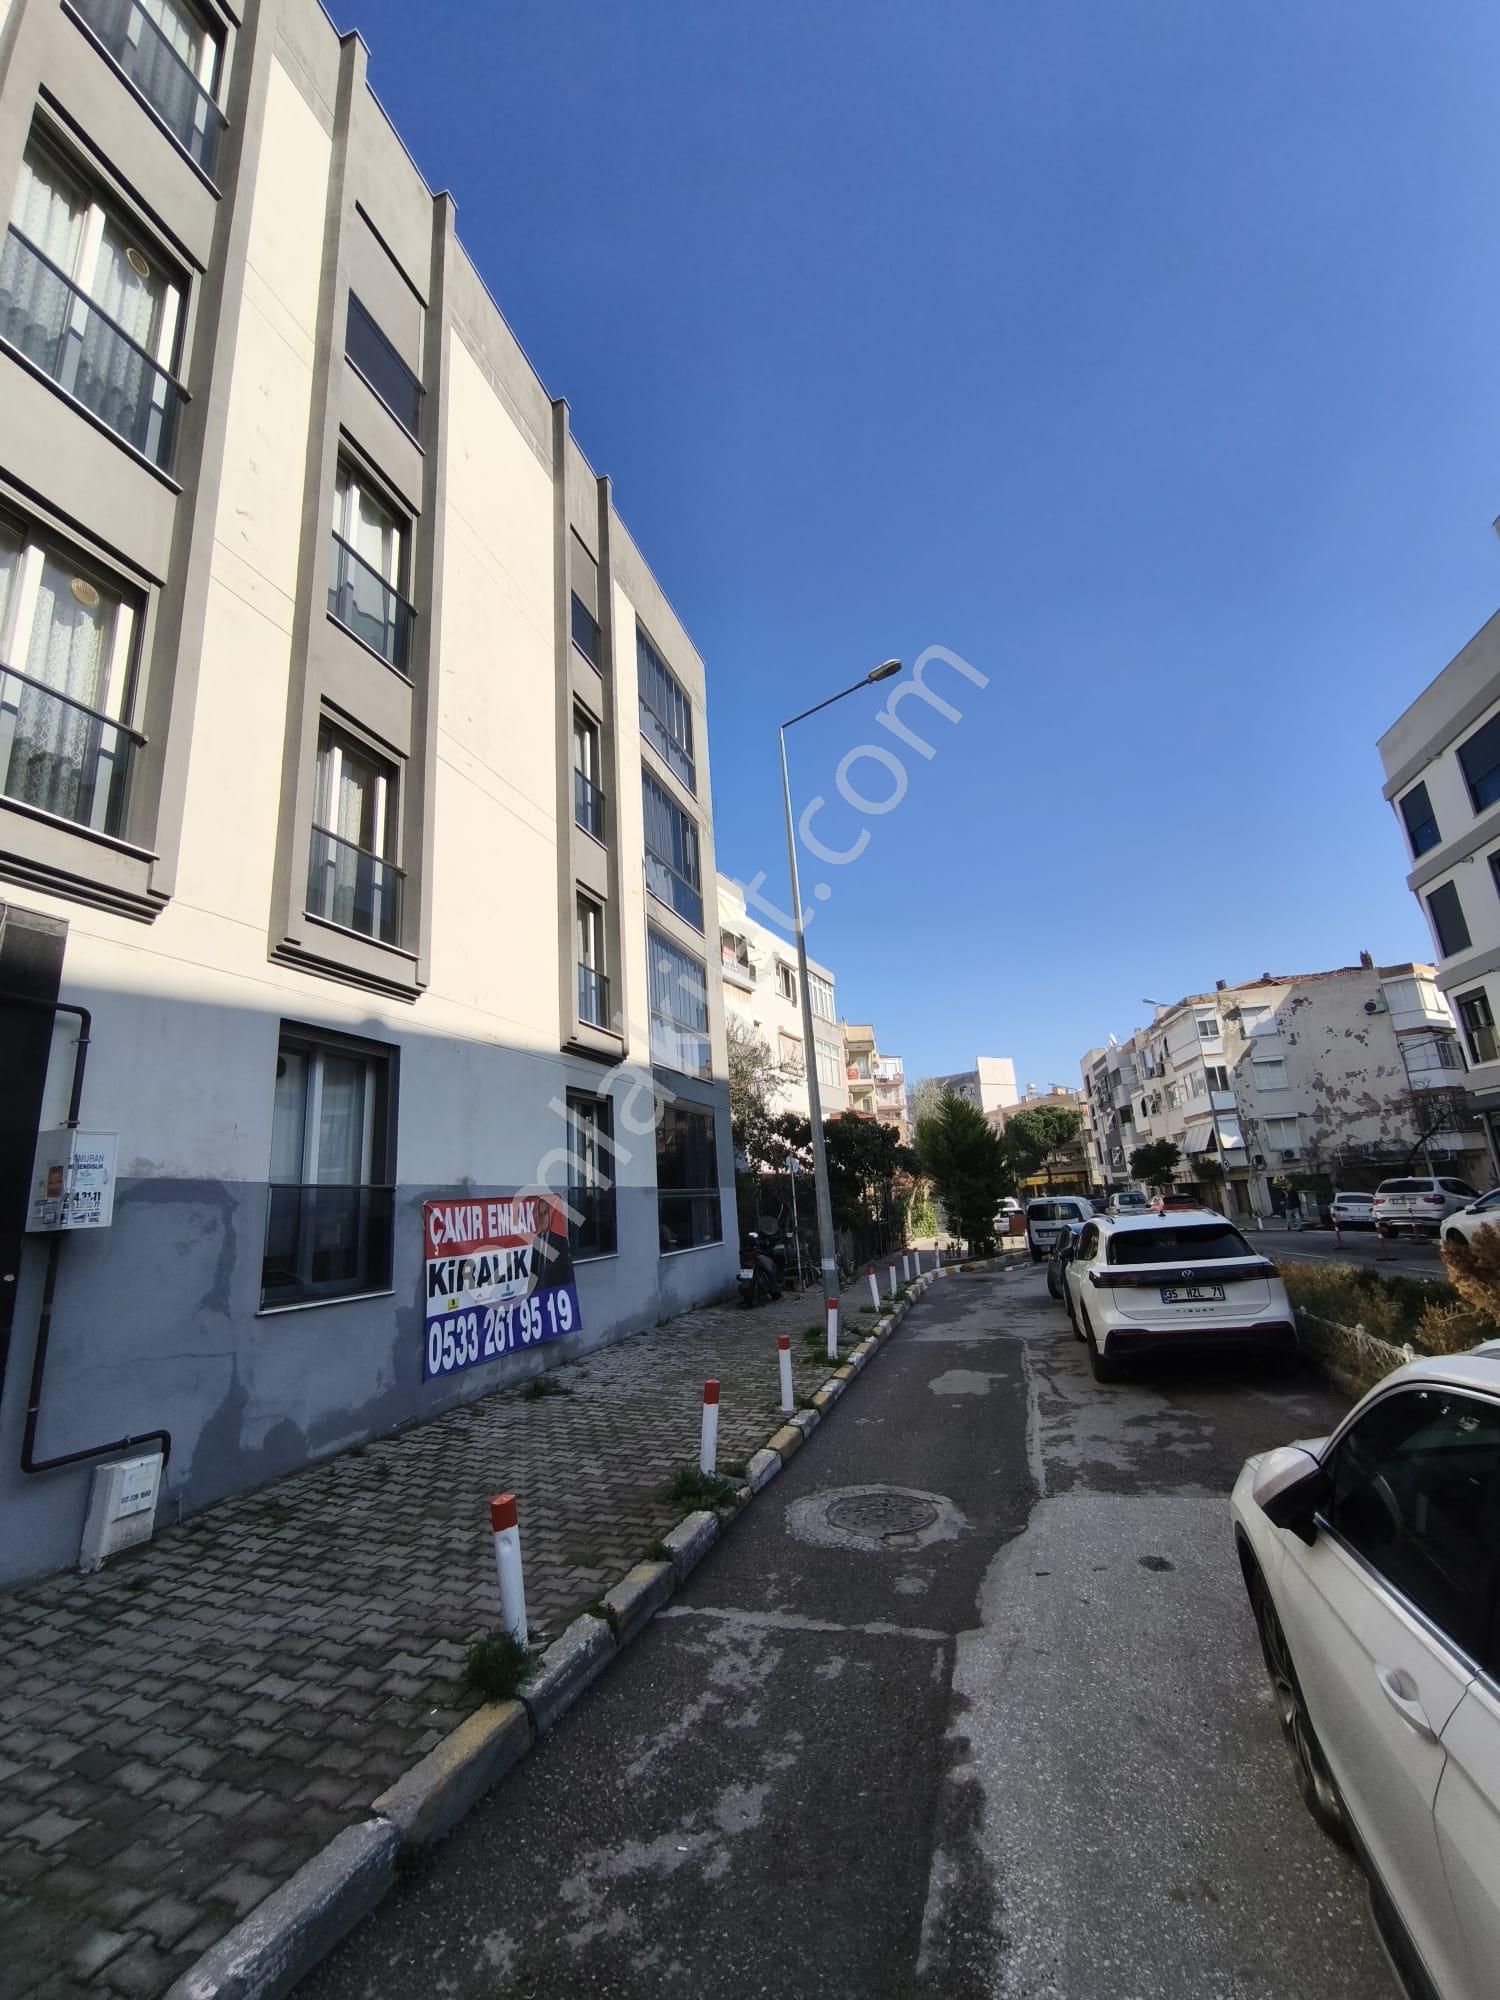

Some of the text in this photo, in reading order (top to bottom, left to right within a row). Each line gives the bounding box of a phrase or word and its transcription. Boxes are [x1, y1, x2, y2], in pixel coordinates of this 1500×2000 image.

[430, 1201, 536, 1255] ÇAKIR EMLAK
[1167, 1289, 1178, 1299] 35
[1211, 1286, 1222, 1297] 71
[429, 1289, 572, 1374] 0533 261 95 19
